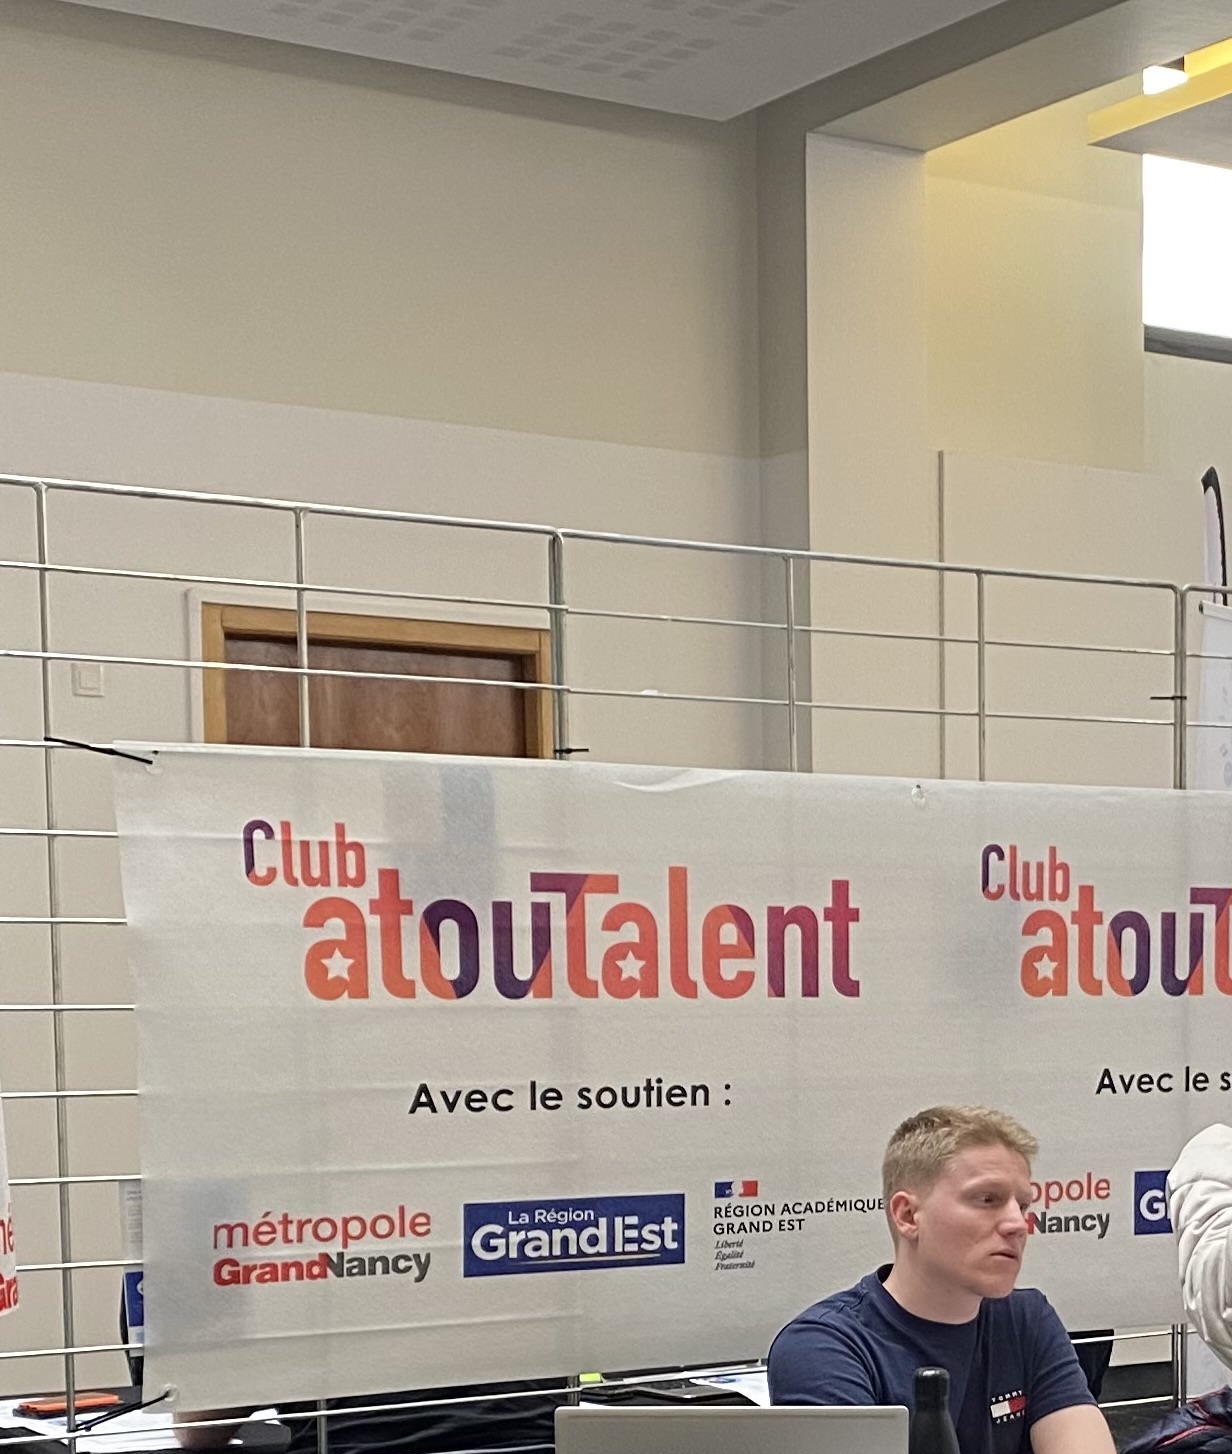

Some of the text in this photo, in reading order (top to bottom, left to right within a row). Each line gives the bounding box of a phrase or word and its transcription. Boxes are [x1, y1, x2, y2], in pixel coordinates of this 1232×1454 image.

[242, 819, 366, 888] Club
[981, 844, 1070, 902] Club
[303, 866, 860, 1001] atouTalent
[408, 1083, 514, 1114] Avec
[530, 1080, 562, 1110] le
[577, 1077, 709, 1109] soutien
[1095, 1067, 1173, 1094] Avec
[1185, 1066, 1210, 1092] le
[1029, 1172, 1111, 1209] opole
[508, 1207, 595, 1225] La Région
[714, 1198, 884, 1218] RÉGION ACADÉMIQUE
[213, 1205, 431, 1249] métropole
[713, 1219, 805, 1235] GRAND EST
[1027, 1212, 1110, 1239] Nancy
[714, 1240, 744, 1249] Liberté
[213, 1252, 431, 1286] GrandNancy
[714, 1261, 755, 1271] Fraternité
